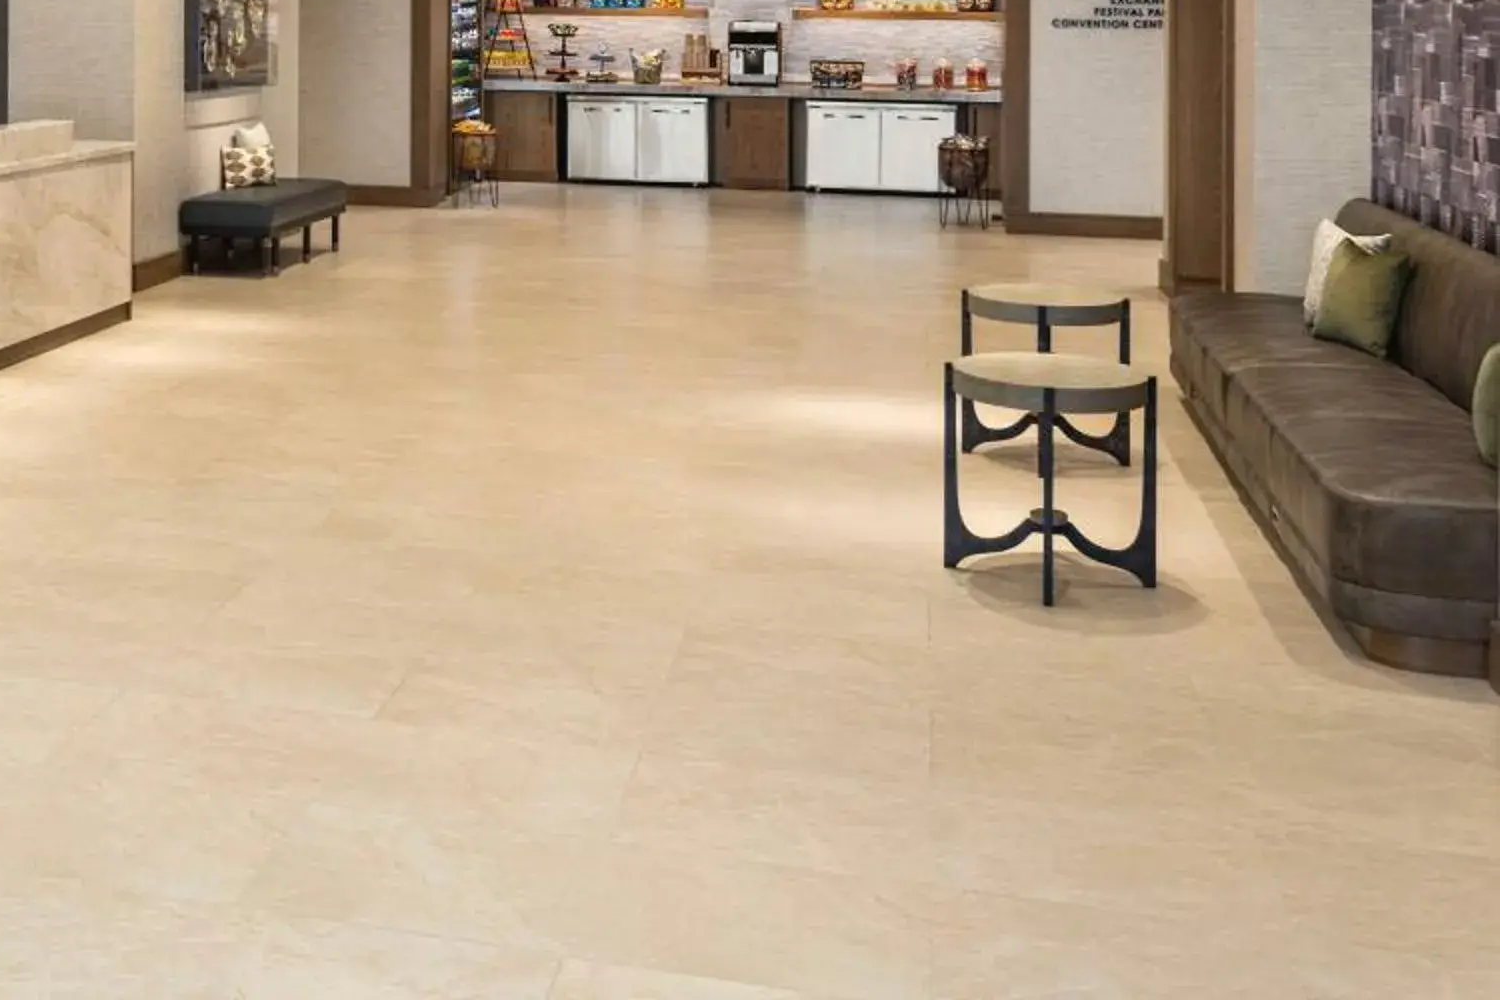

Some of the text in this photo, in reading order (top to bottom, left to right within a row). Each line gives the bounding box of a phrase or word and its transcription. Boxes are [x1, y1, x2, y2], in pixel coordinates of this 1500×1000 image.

[1094, 8, 1164, 16] FESTIVAL PA
[1051, 19, 1129, 28] CONVENTION
